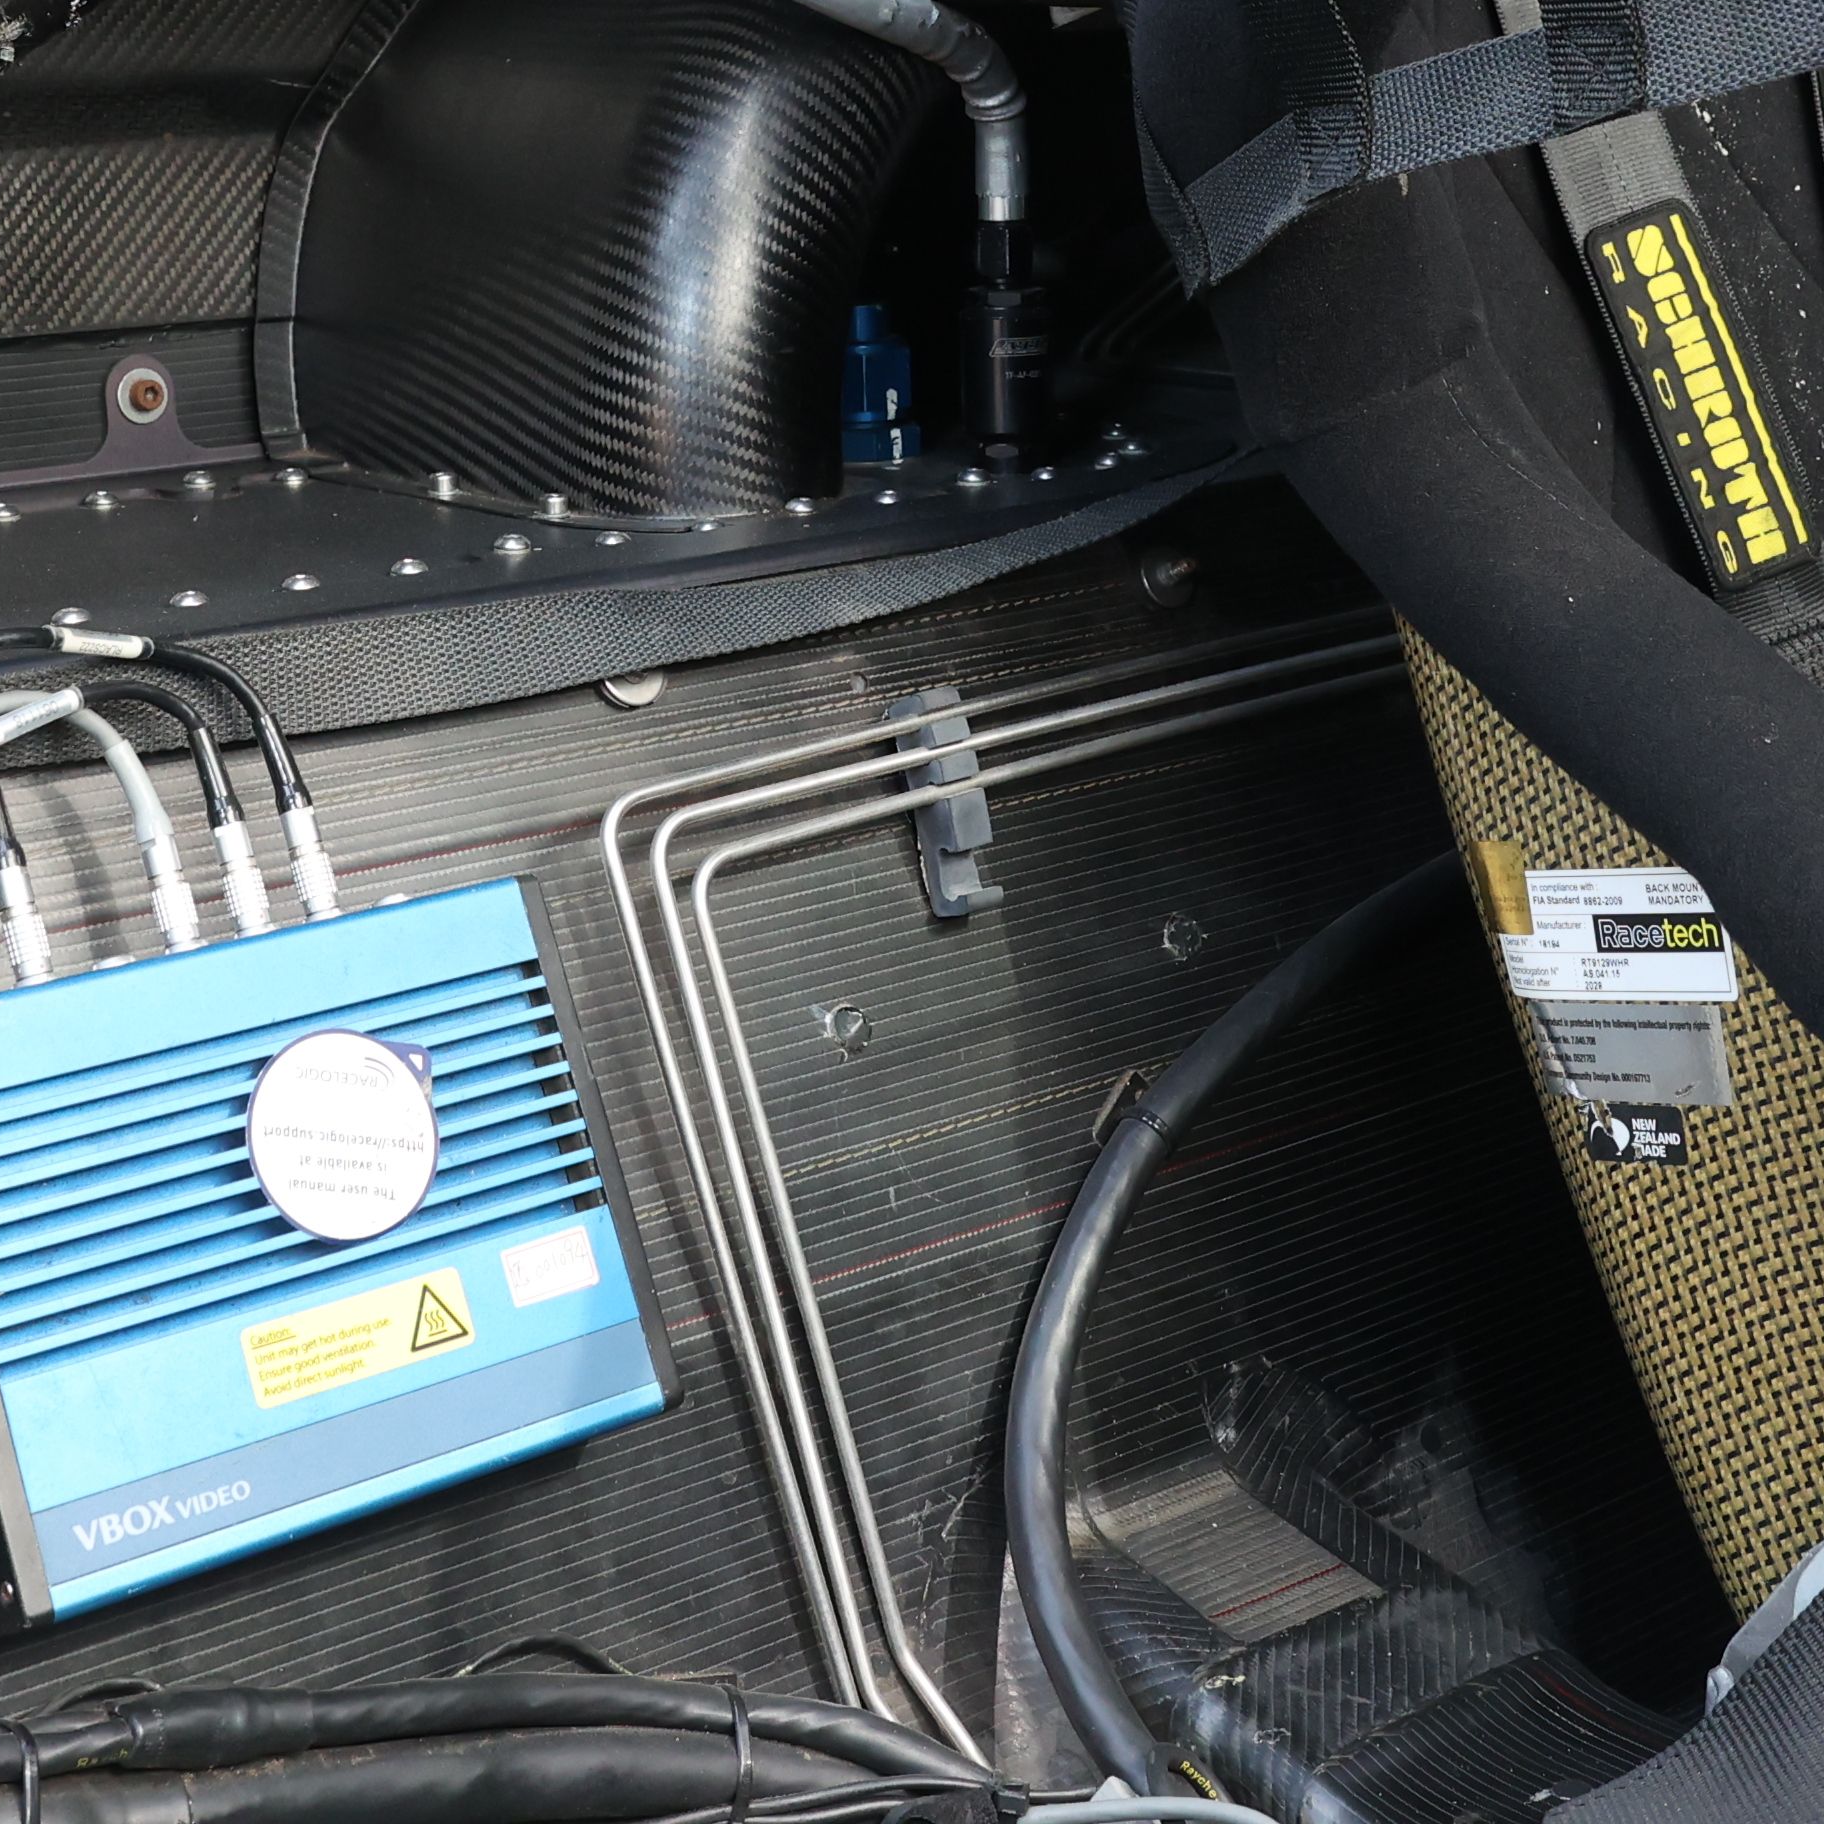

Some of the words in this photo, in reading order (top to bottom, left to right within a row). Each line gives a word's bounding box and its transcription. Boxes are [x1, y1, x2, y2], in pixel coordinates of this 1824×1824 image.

[1625, 222, 1788, 567] SCHROTH
[1600, 241, 1739, 578] RACING
[1646, 883, 1670, 893] BACK
[1533, 896, 1546, 905] FIA
[1547, 895, 1580, 905] Standard
[1648, 895, 1704, 905] MANDATORY
[1536, 920, 1582, 930] Manufacturer
[1598, 917, 1719, 948] Racetech
[1631, 1118, 1657, 1131] NEW
[1633, 1131, 1681, 1145] ZEALAND
[317, 1157, 373, 1171] available
[289, 1178, 335, 1192] manual
[341, 1184, 368, 1194] user
[374, 1187, 396, 1201] The
[255, 1352, 276, 1366] Unit
[278, 1347, 299, 1362] may
[302, 1340, 318, 1354] get
[319, 1332, 337, 1347] hot
[339, 1323, 372, 1343] during
[258, 1363, 293, 1382] Ensure
[294, 1354, 320, 1372] good
[264, 1381, 293, 1398] Avoid
[294, 1372, 322, 1389] direct
[72, 1495, 175, 1552] VBOX
[175, 1479, 252, 1520] VIDEO
[1179, 1759, 1218, 1802] Rayche
